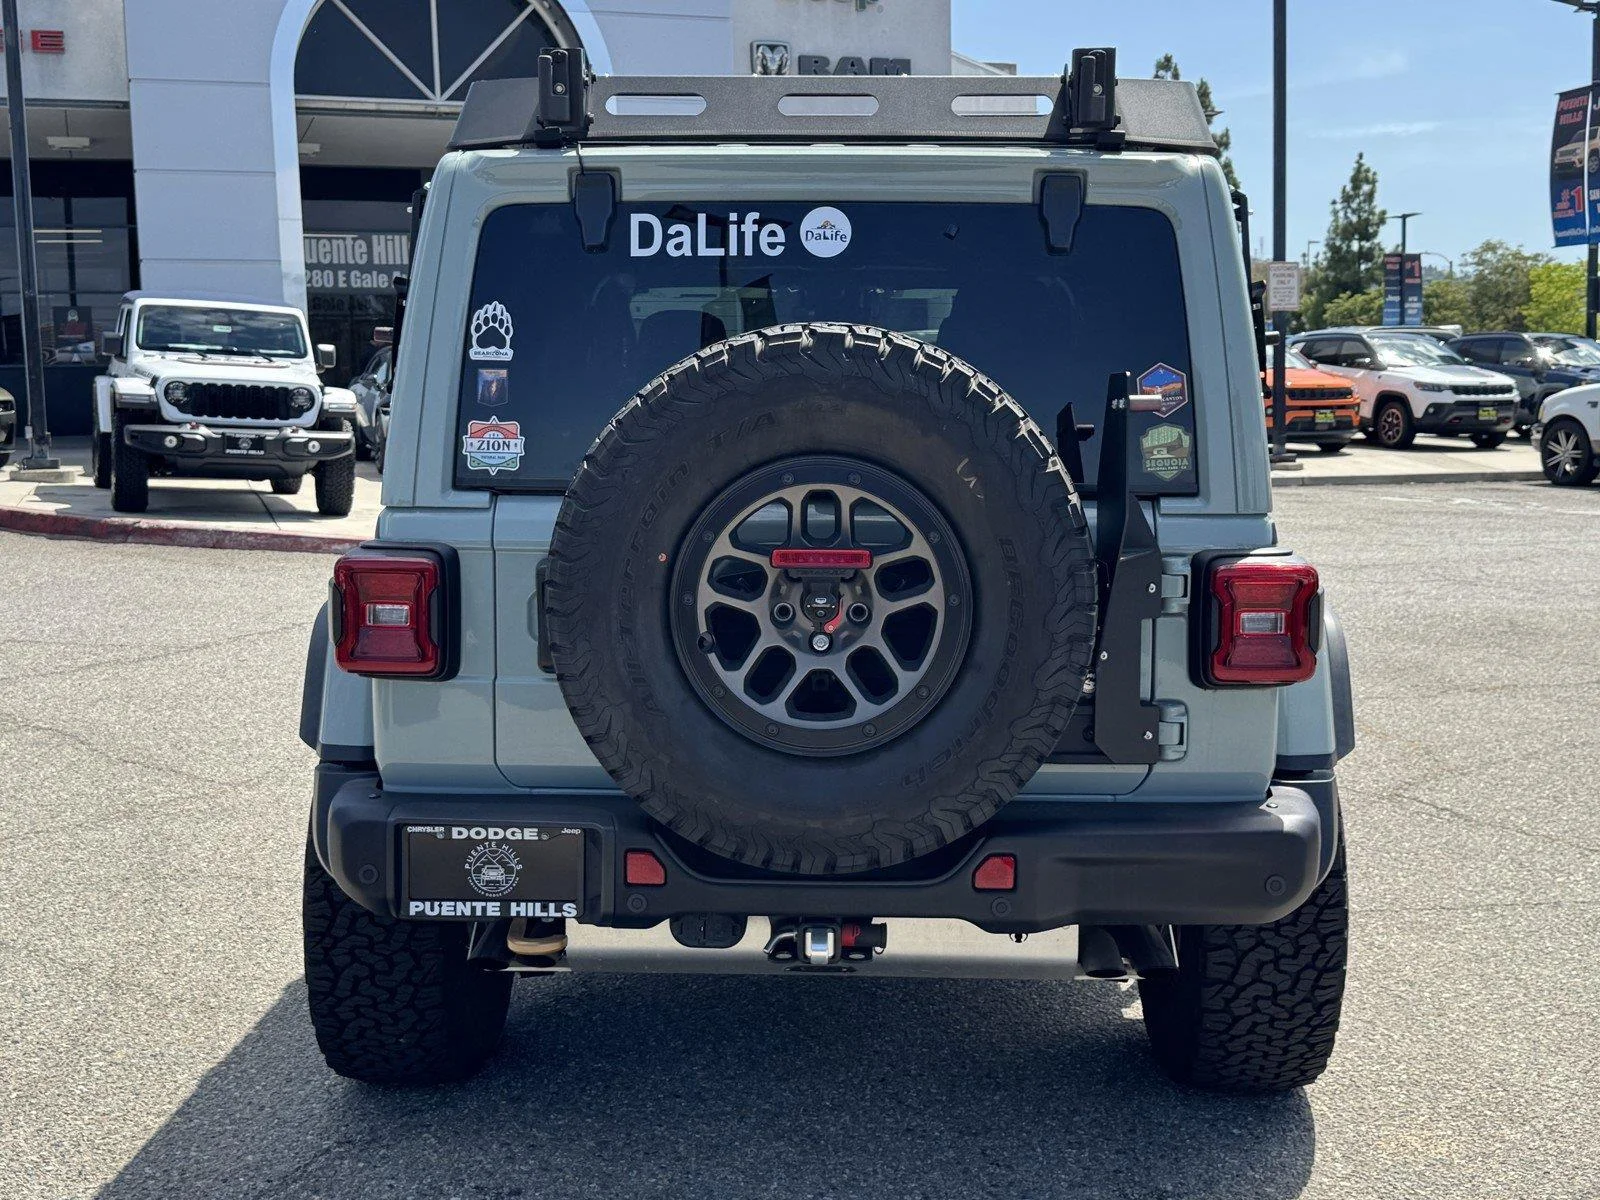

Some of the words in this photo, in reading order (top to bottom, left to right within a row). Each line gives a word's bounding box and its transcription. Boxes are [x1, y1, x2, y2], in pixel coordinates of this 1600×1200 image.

[798, 55, 911, 76] RAM
[630, 211, 786, 257] DaLife
[805, 230, 847, 243] DaLife
[304, 236, 368, 265] uente
[372, 235, 411, 265] Hill
[305, 270, 334, 288] 280
[337, 270, 348, 288] E
[350, 270, 389, 288] Gale
[477, 440, 511, 451] ZION
[1145, 458, 1189, 467] SEQUOIA
[452, 827, 538, 840] DODGE
[561, 827, 581, 835] Jeep
[464, 841, 497, 869] PUENTE
[502, 844, 523, 870] HILLS
[409, 901, 500, 916] PUENTE
[510, 902, 578, 917] HILLS
